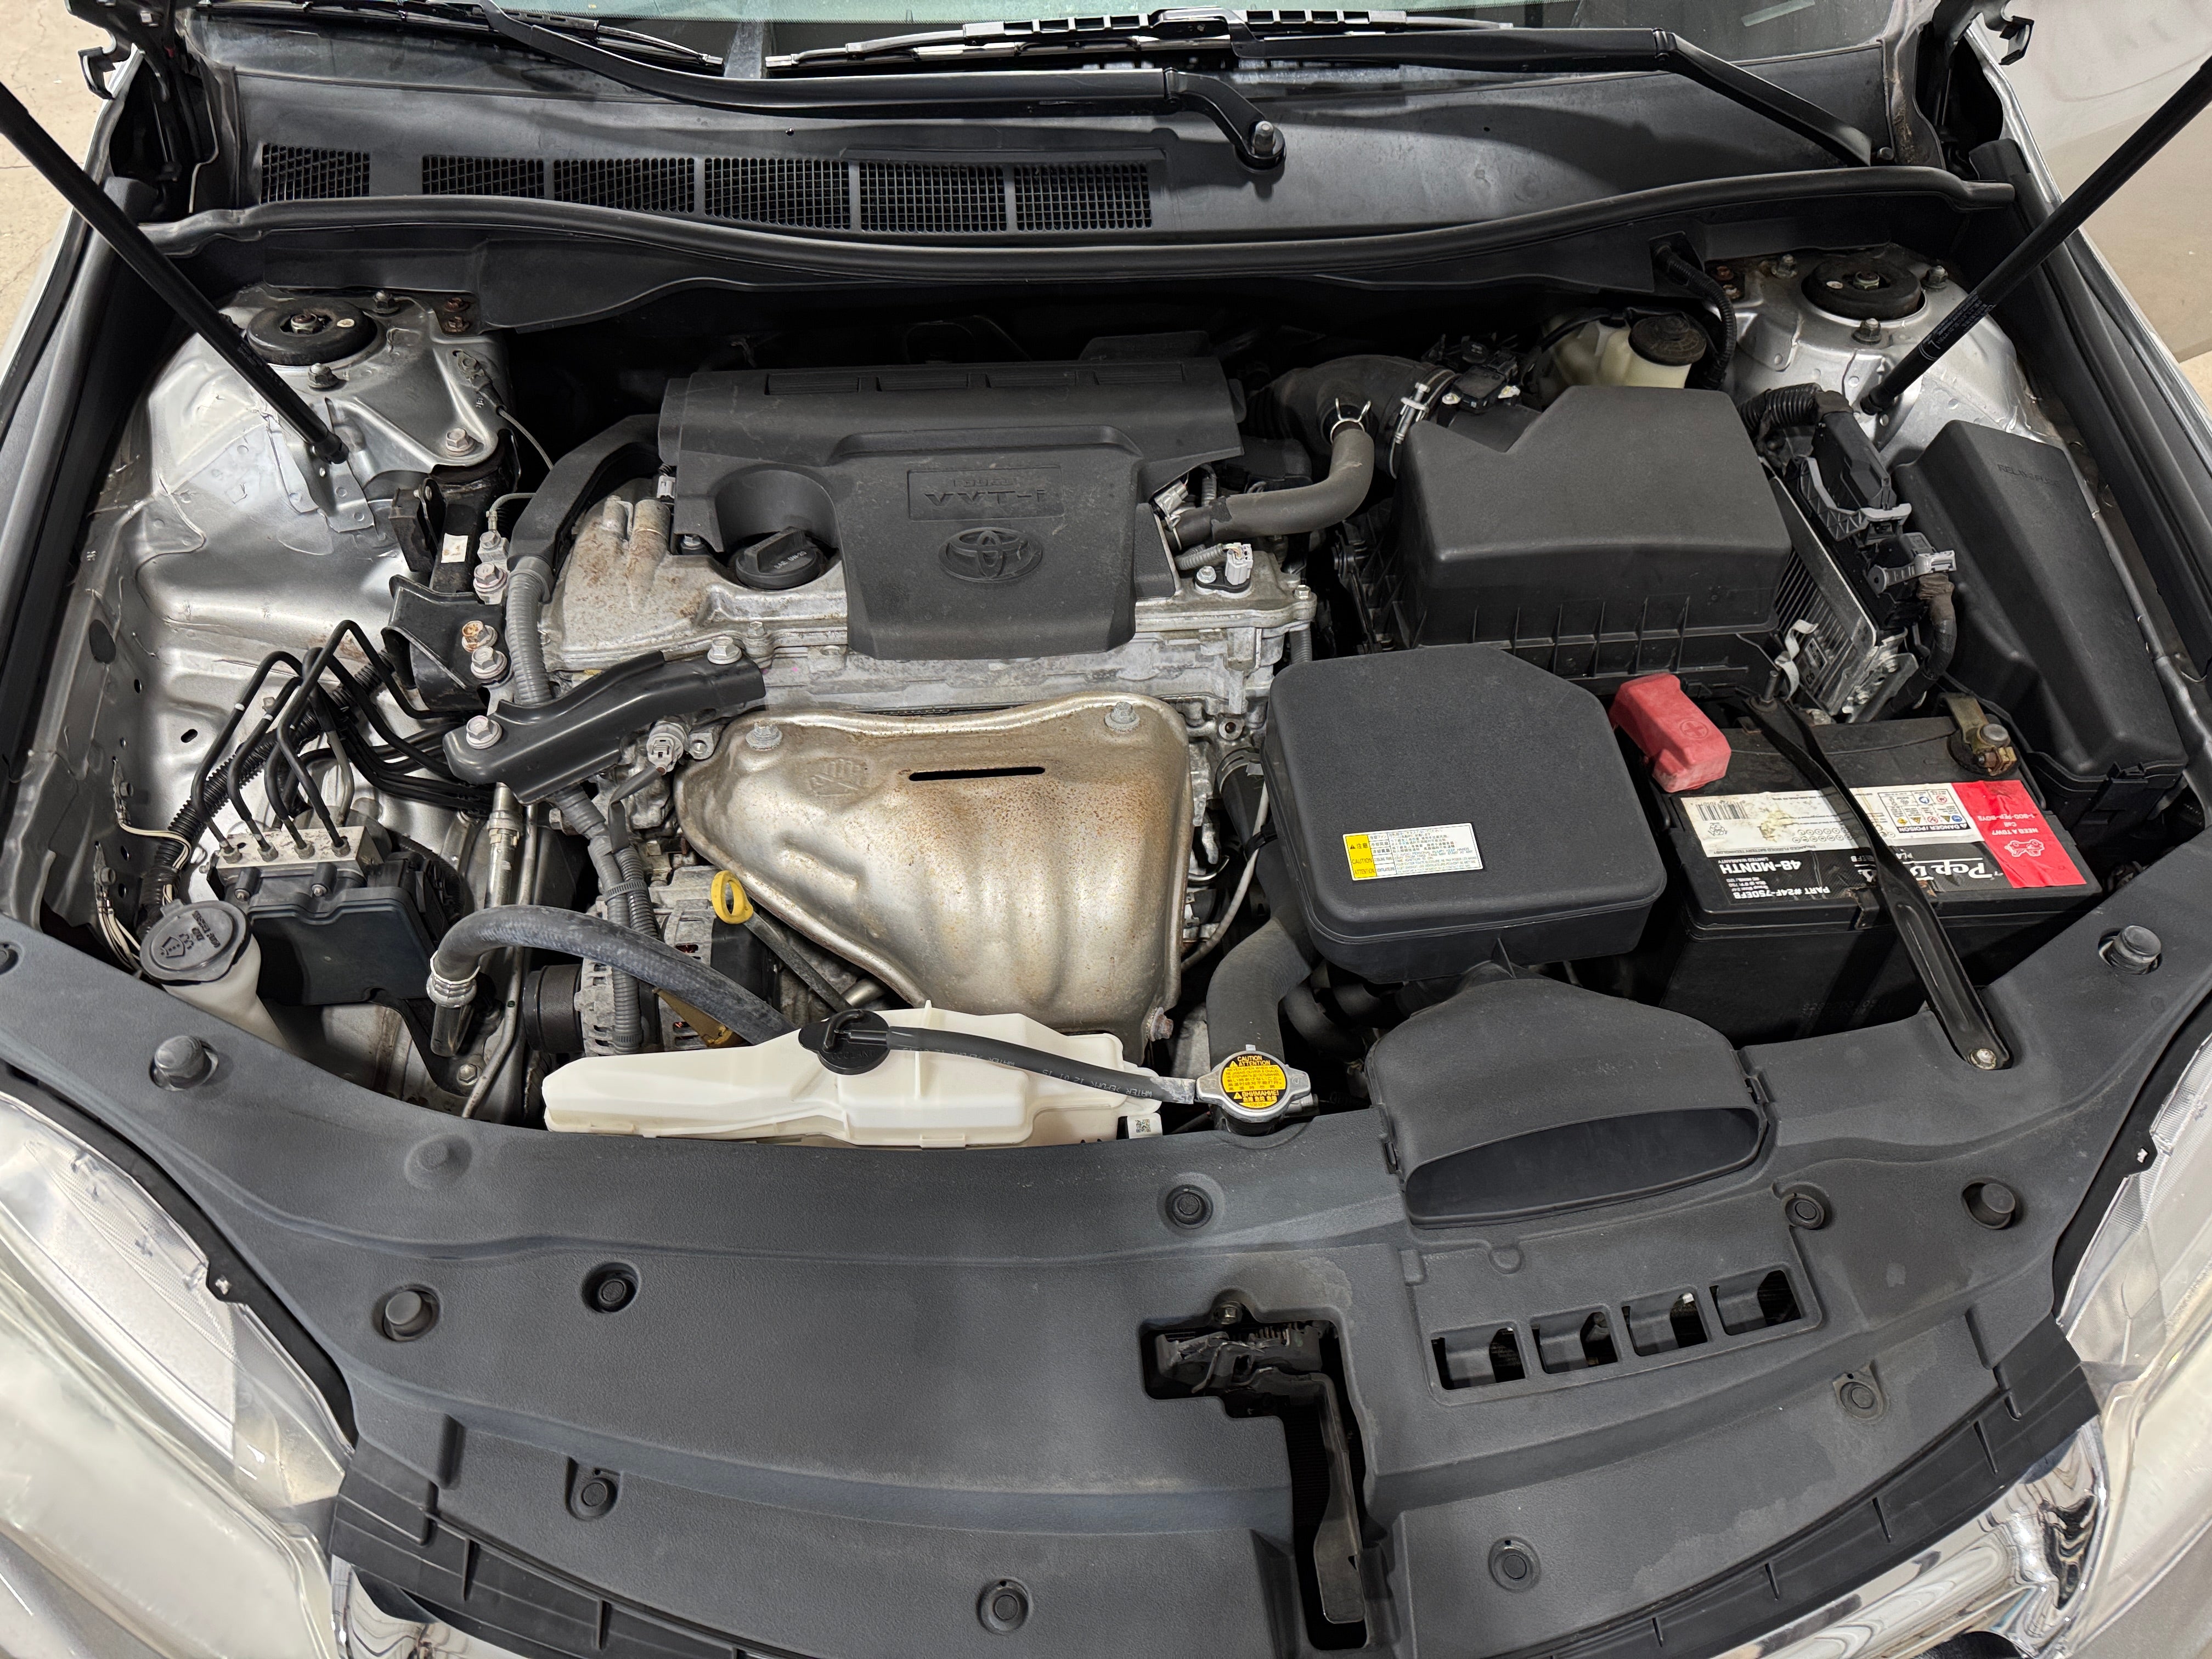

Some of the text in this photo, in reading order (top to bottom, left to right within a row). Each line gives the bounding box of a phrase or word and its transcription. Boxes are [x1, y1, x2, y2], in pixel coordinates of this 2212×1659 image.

[774, 551, 808, 569] SAE 0W-20
[1806, 670, 1815, 685] C6
[1977, 813, 2036, 821] 1-800-PEP-BOYS
[1719, 860, 1802, 874] 48-MONTH
[1930, 860, 1993, 879] Pep
[1733, 886, 1831, 899] PART #24F-750EFB
[831, 1049, 874, 1060] COOLANT
[1126, 1087, 1153, 1098] WATER
